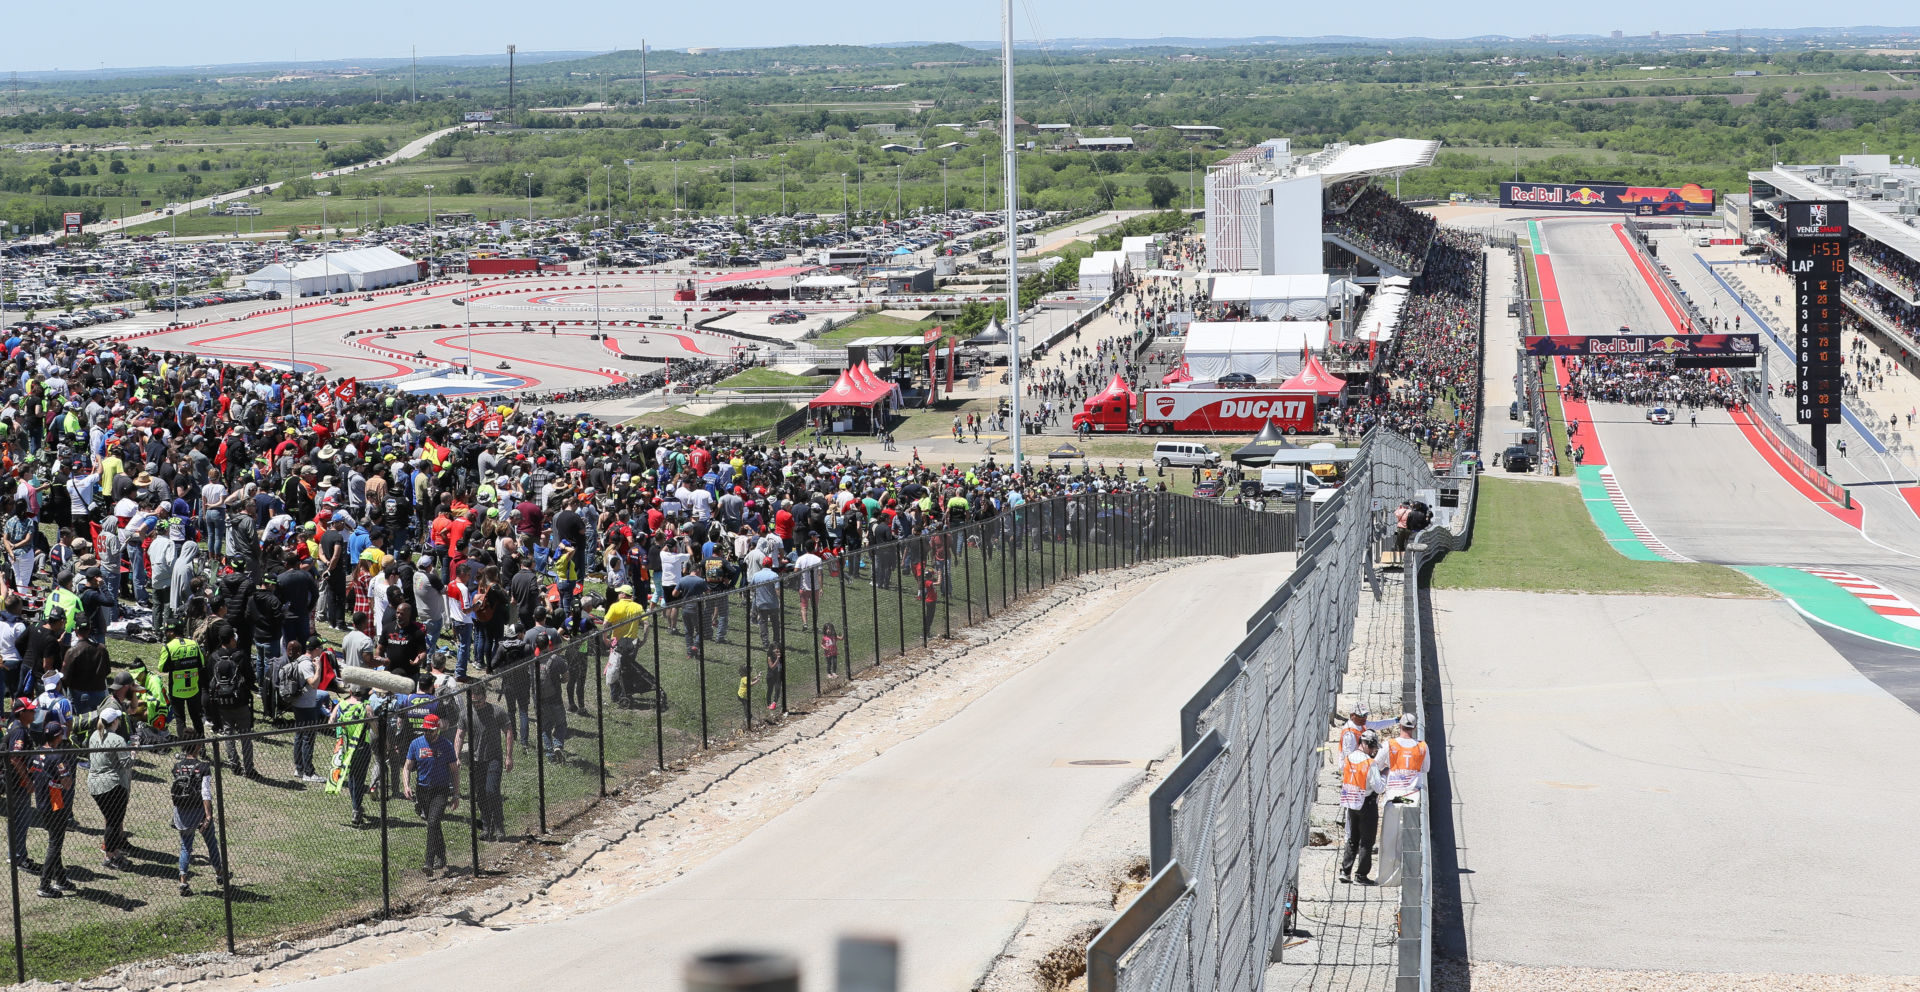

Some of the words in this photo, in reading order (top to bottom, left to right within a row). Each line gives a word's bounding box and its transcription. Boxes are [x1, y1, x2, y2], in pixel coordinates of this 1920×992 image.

[1511, 186, 1537, 201] Red
[1538, 188, 1562, 203] Bull
[1812, 242, 1840, 256] 1:53
[1792, 260, 1814, 272] LAP
[1832, 259, 1844, 272] 18
[1802, 281, 1807, 291] 1
[1818, 280, 1828, 290] 12
[1802, 295, 1808, 305] 2
[1817, 295, 1828, 304] 23
[1802, 310, 1808, 319] 3
[1802, 324, 1808, 333] 4
[1590, 338, 1617, 353] Red
[1618, 338, 1644, 353] Bull
[1802, 338, 1808, 347] 5
[1802, 352, 1808, 362] 6
[1819, 352, 1828, 361] 10
[1802, 367, 1808, 376] 7
[1802, 381, 1808, 390] 8
[1803, 395, 1808, 404] 9
[1819, 395, 1829, 404] 33
[1219, 400, 1306, 418] DUCATI
[1800, 409, 1811, 419] 10
[1823, 409, 1829, 418] 5
[97, 536, 107, 552] 93
[172, 646, 198, 660] 46
[1402, 754, 1412, 768] T
